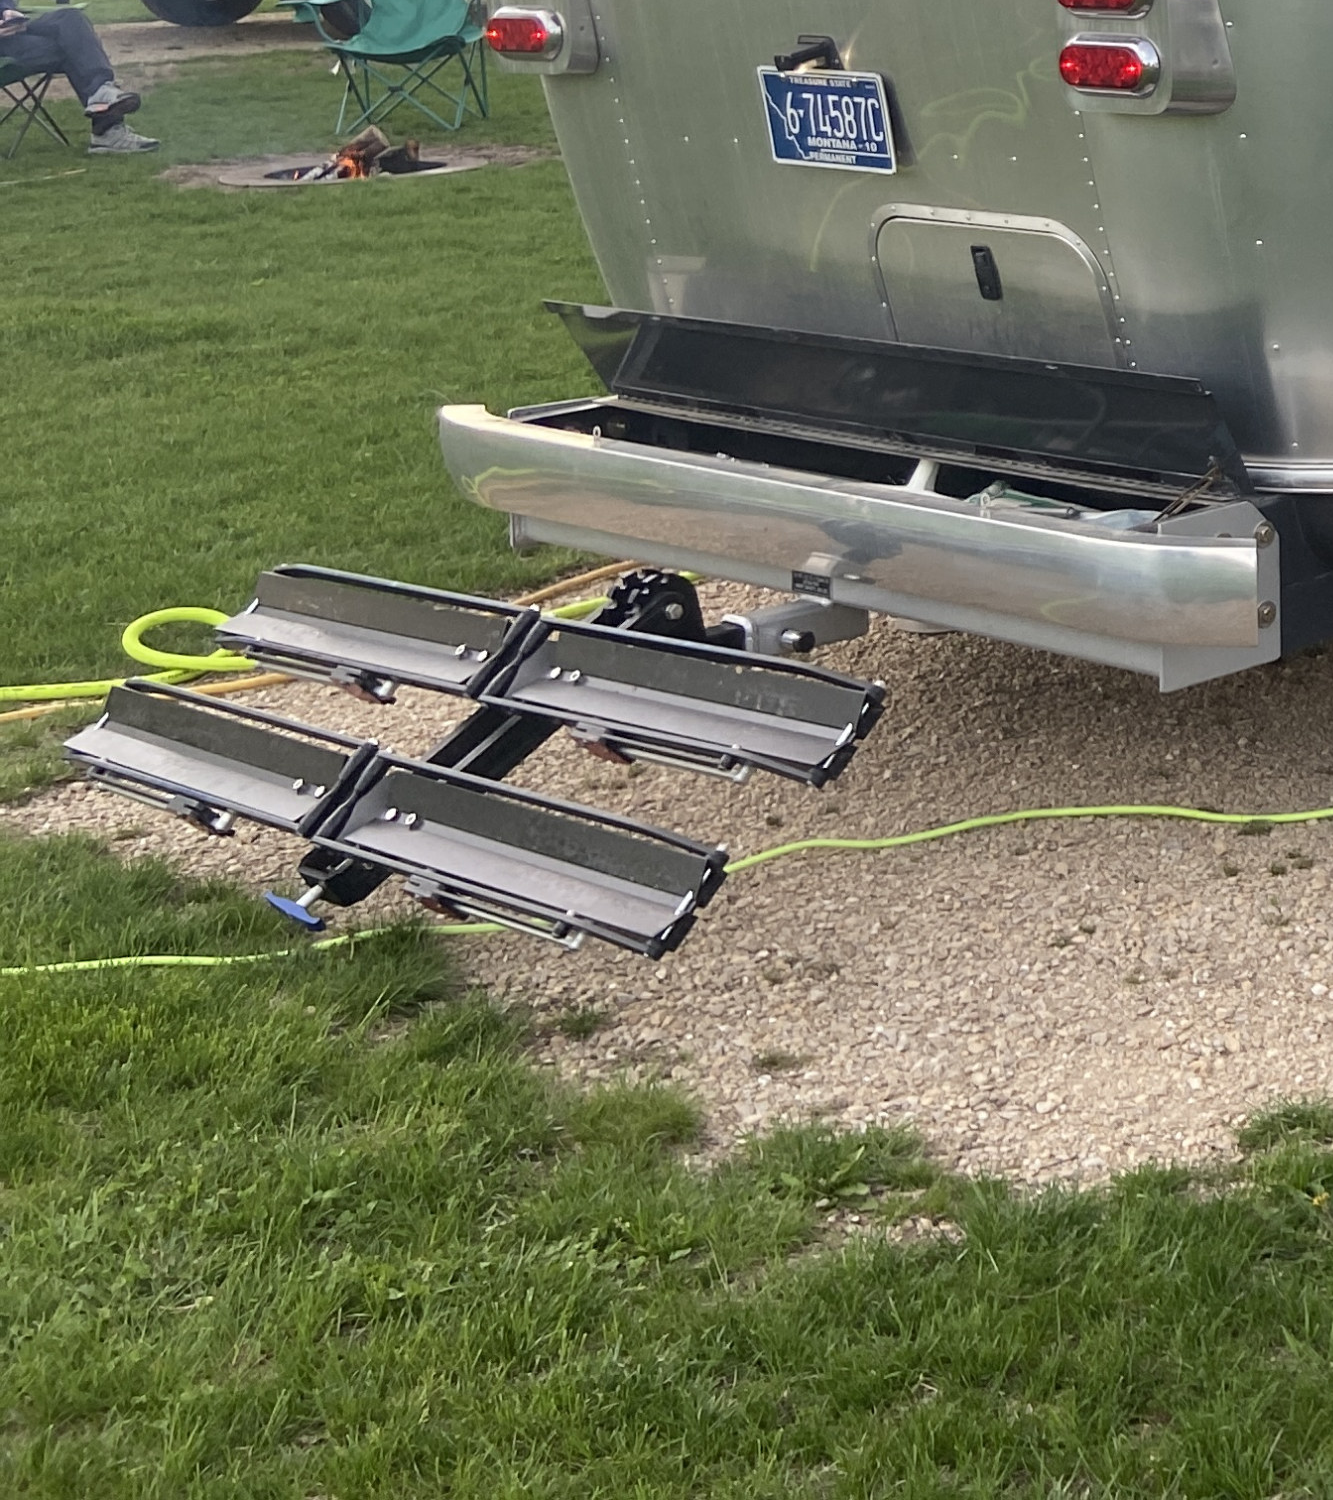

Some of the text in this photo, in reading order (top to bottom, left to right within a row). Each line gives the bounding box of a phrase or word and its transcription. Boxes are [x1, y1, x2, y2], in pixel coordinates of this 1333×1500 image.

[788, 76, 828, 87] TREASURE
[829, 78, 852, 88] STATE
[807, 136, 858, 151] MONTANA
[809, 151, 858, 165] PERMANENT
